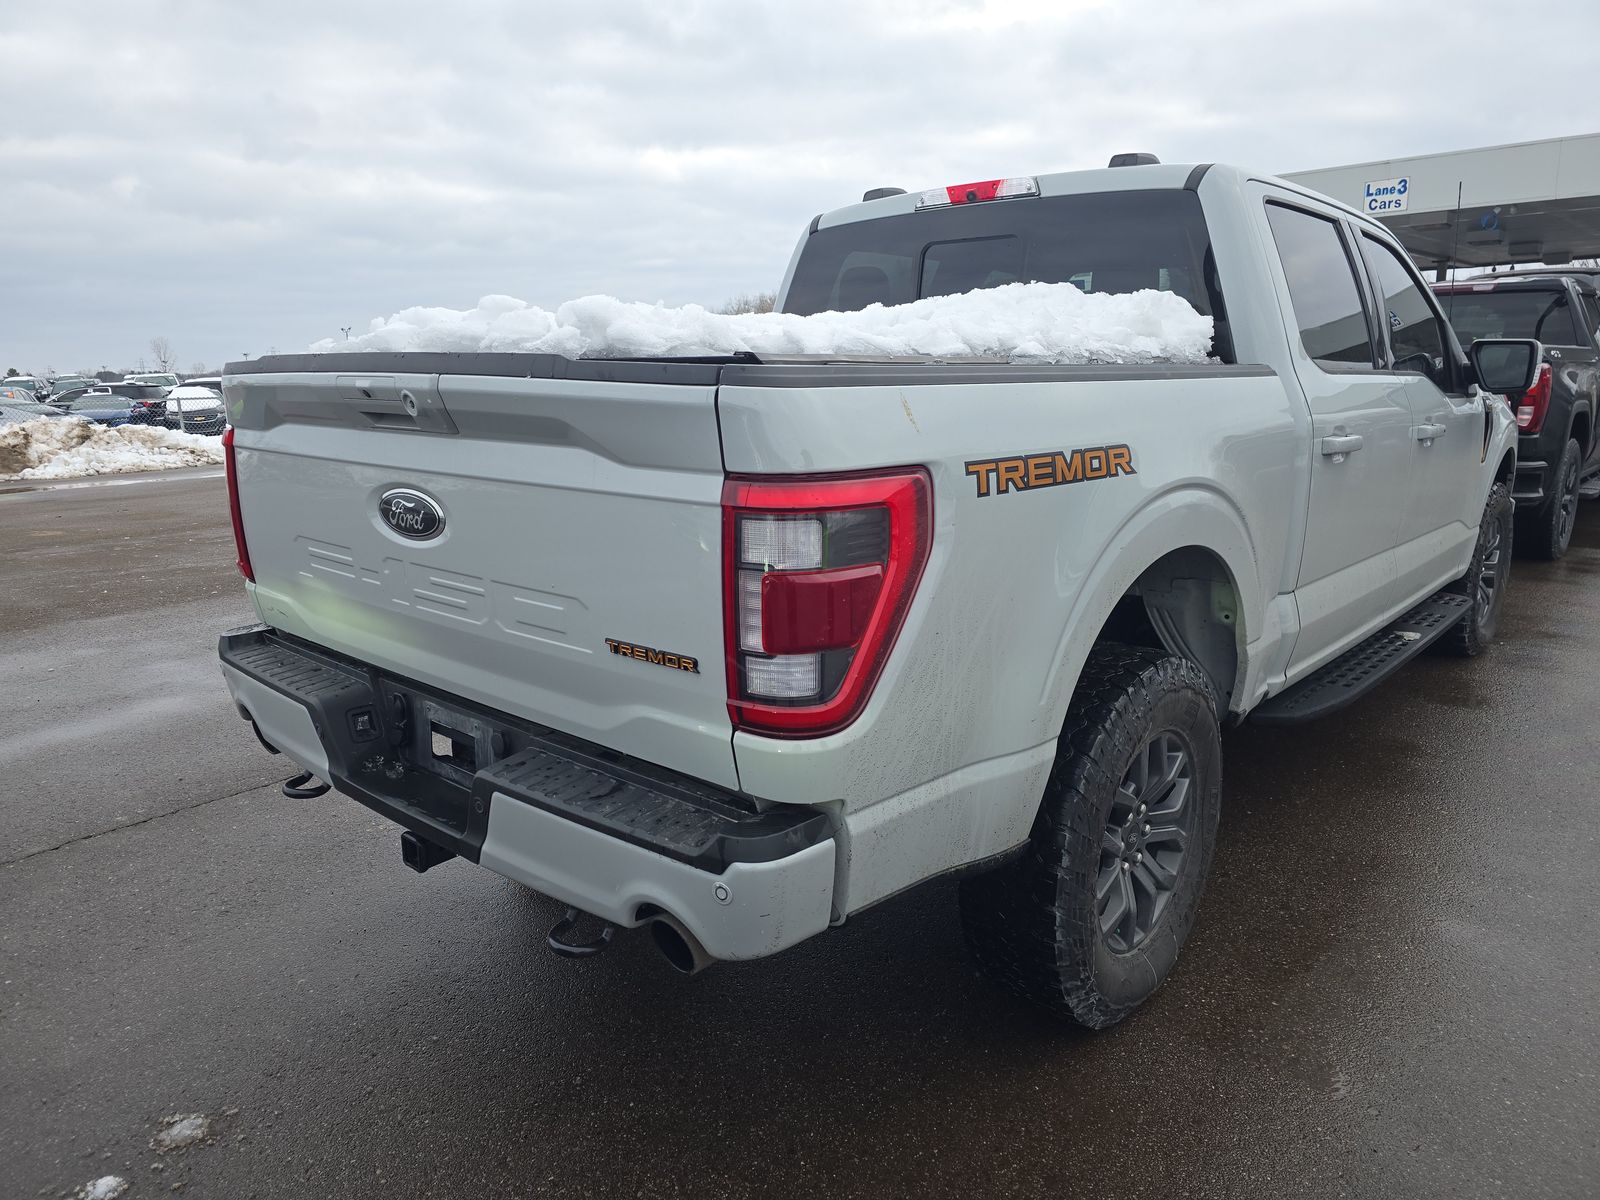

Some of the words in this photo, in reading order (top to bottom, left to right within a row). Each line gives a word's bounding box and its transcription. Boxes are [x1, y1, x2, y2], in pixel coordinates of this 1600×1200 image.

[1368, 198, 1402, 211] Cars
[965, 443, 1137, 498] TREMOR
[389, 498, 425, 530] Ford
[605, 637, 700, 674] TREMOR
